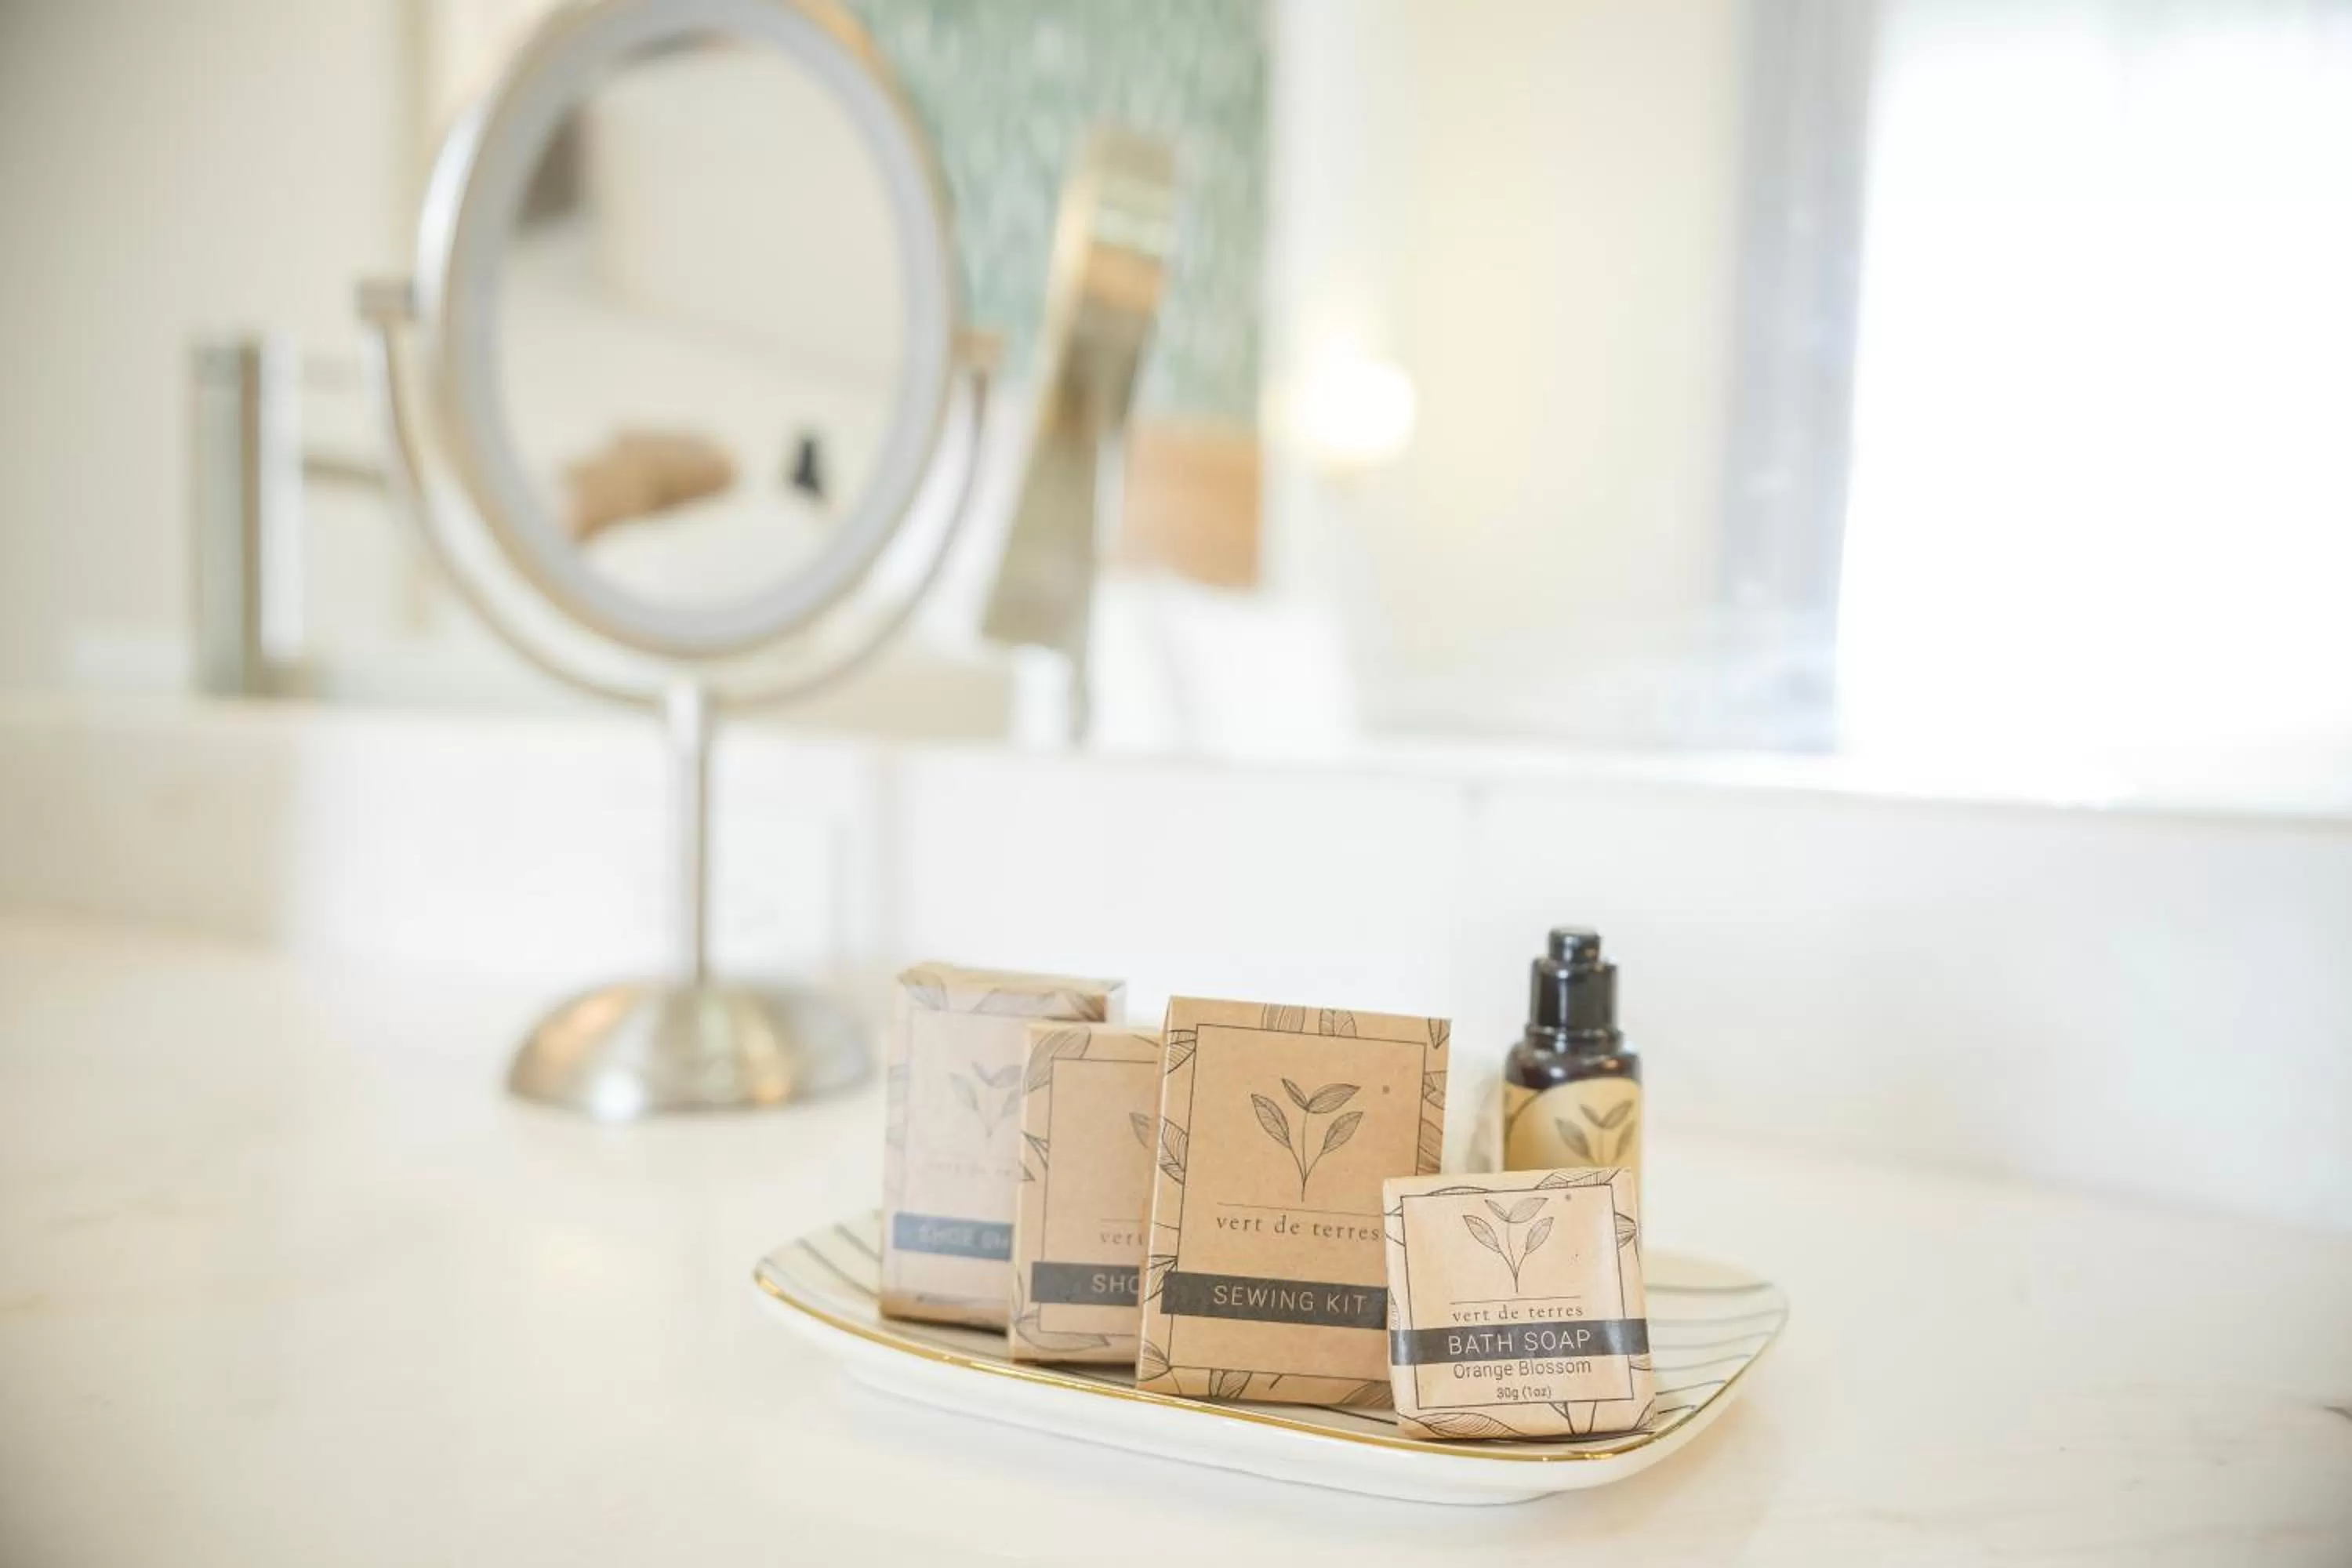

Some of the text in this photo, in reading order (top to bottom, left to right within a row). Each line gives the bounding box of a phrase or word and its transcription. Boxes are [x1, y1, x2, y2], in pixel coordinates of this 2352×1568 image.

[1217, 1215, 1380, 1241] vert de terres
[1214, 1285, 1368, 1315] SEWING KIT
[1453, 1305, 1584, 1323] vert de terres
[1448, 1329, 1592, 1356] BATH SOAP
[1454, 1359, 1592, 1380] Orange Blossom
[1496, 1385, 1552, 1400] 30g (1oz)
